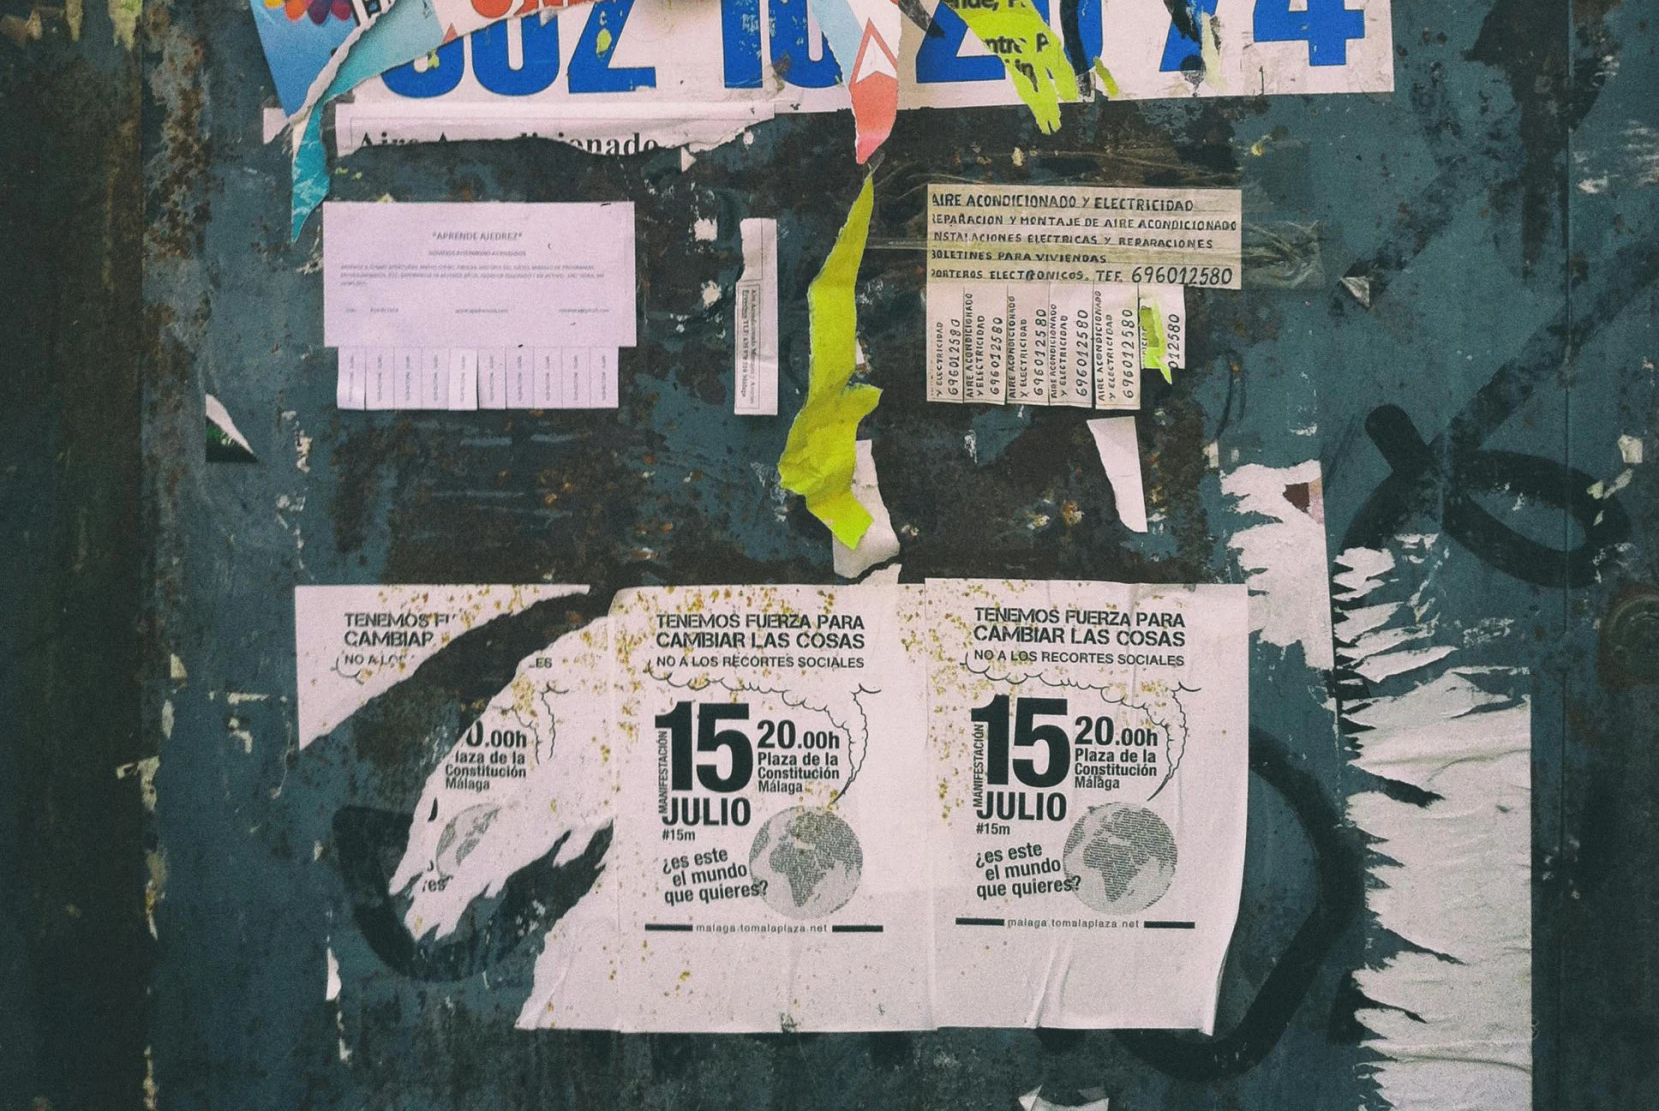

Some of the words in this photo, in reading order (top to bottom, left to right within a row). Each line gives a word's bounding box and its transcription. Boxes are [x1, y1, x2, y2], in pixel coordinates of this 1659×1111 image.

[932, 194, 962, 208] AIRE
[966, 194, 1077, 209] ACONDICIONADO
[1082, 196, 1091, 208] Y
[1094, 196, 1194, 212] ELECTRICIDAD
[1010, 216, 1016, 225] Y
[1020, 216, 1081, 227] MONTAJE
[1084, 218, 1099, 228] DE
[1104, 218, 1134, 229] AIRE
[1138, 219, 1237, 231] ACONDICIONADO
[1028, 233, 1098, 245] ELECTRICAS
[1104, 236, 1111, 245] Y
[1118, 236, 1213, 249] REPARACIONES
[998, 251, 1032, 262] PARA
[1036, 253, 1107, 264] VIVIENDAS
[1132, 266, 1233, 286] 696012580
[975, 607, 1060, 624] TENEMOS
[1065, 610, 1131, 627] FUERZA
[1136, 612, 1186, 629] PARA
[974, 626, 1065, 645] CAMBIAR
[1071, 628, 1110, 646] LAS
[1117, 629, 1186, 647] COSAS
[974, 649, 995, 661] NO
[998, 650, 1007, 661] A
[1010, 650, 1038, 663] LOS
[1041, 652, 1115, 665] RECORTES
[1118, 653, 1185, 667] SOCIALES
[971, 694, 1071, 789] 15
[1074, 716, 1158, 747] 20.00h
[1075, 747, 1115, 763] Plaza
[1120, 748, 1139, 763] de
[1142, 748, 1156, 764] la
[974, 724, 985, 808] MANIFESTACIÓN
[1074, 762, 1157, 777] Constitución
[1075, 774, 1120, 791] Málaga
[976, 790, 1068, 822] JULIO
[976, 822, 1011, 836] #15m
[976, 848, 1004, 868] ¿es
[1008, 842, 1043, 861] este
[985, 863, 1001, 881] el
[1004, 857, 1062, 880] mundo
[976, 884, 1007, 901] que
[1012, 875, 1082, 899] quieres?
